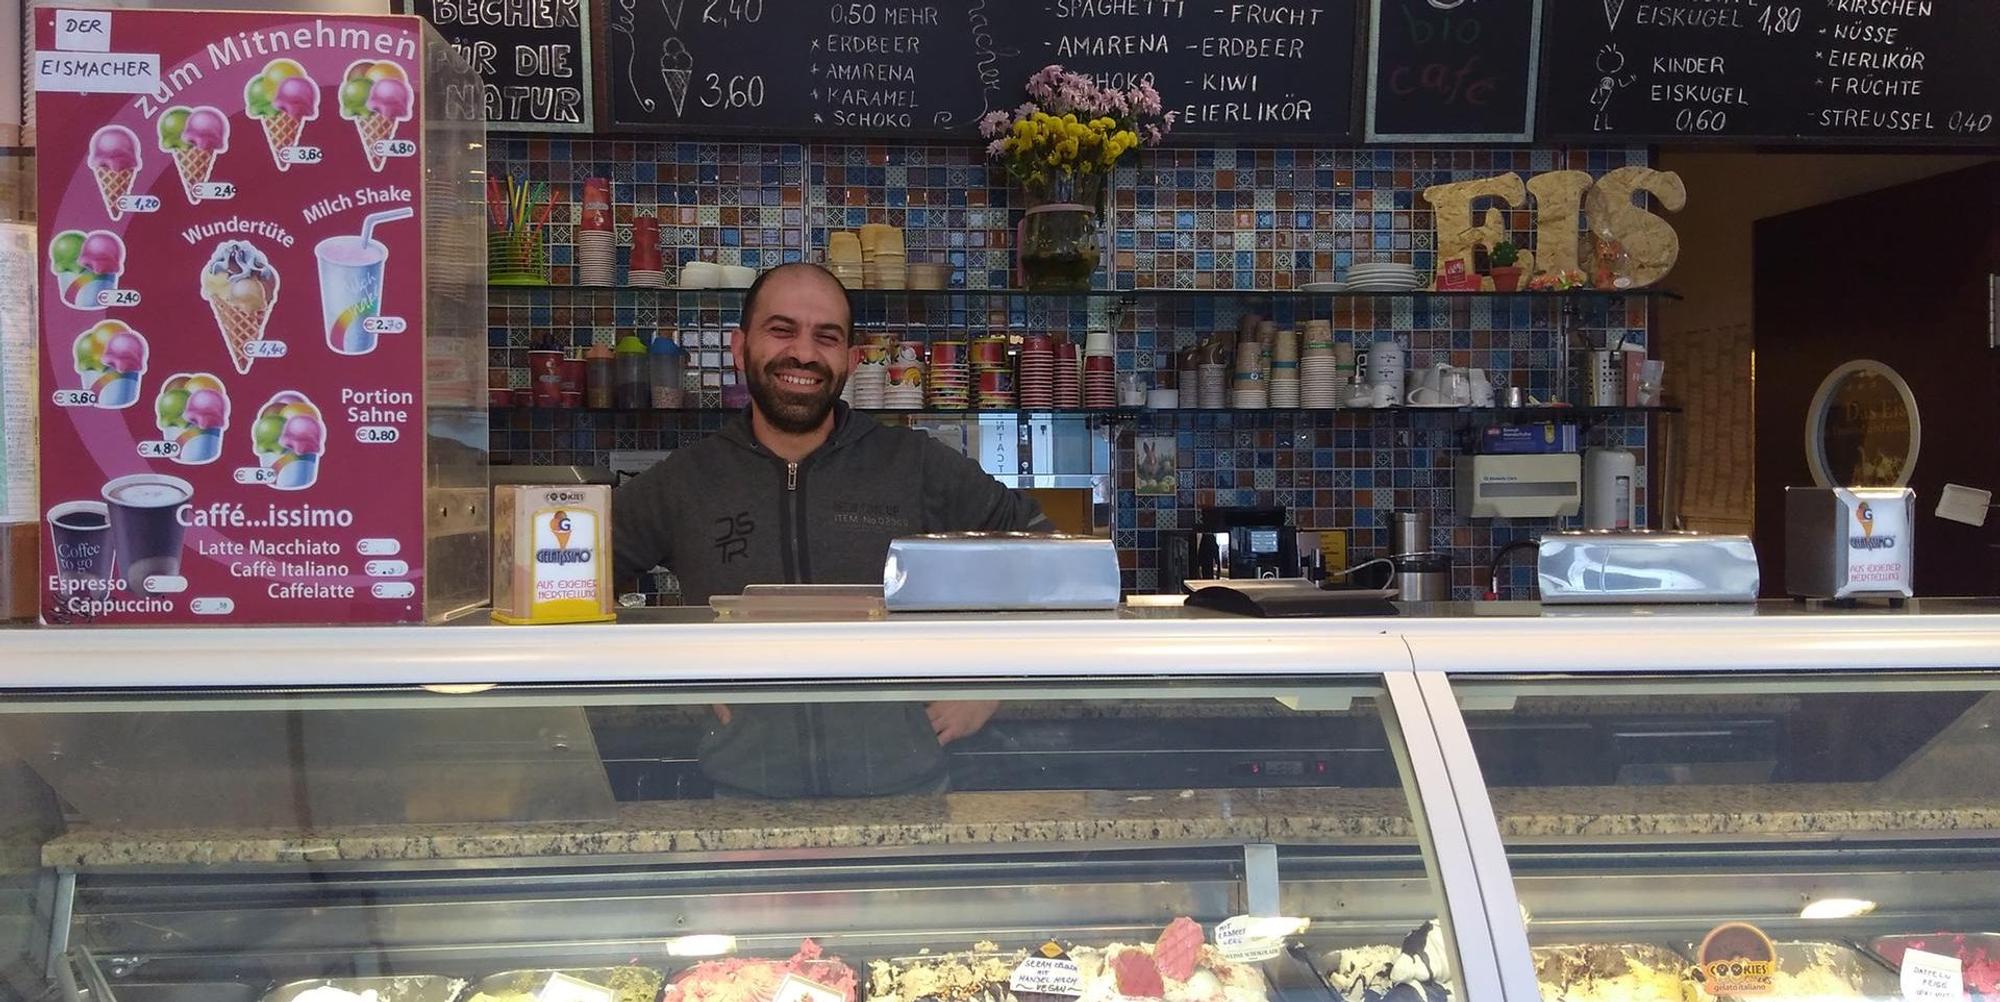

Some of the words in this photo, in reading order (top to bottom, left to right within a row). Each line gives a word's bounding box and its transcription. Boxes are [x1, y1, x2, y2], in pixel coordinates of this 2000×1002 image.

[432, 0, 580, 28] BECHER
[702, 0, 763, 28] 2,40
[831, 4, 876, 25] 0,50
[885, 7, 939, 26] MEHR
[1057, 0, 1184, 18] SPAGHETTI
[1231, 4, 1324, 26] FRUCHT
[1837, 0, 1932, 17] KIRSCHEN
[66, 19, 103, 34] DER
[1637, 5, 1743, 28] EISKUGEL
[1758, 6, 1801, 36] 1,80
[1834, 20, 1898, 45] NÜSSE
[827, 34, 920, 54] ERDBEER
[1057, 34, 1169, 58] AMARENA
[1202, 37, 1304, 59] ERDBEER
[41, 60, 152, 77] EISMACHER
[515, 44, 573, 78] DIE
[1653, 56, 1725, 75] KINDER
[1828, 48, 1925, 70] EIERLIKÖR
[134, 61, 203, 120] zum
[207, 20, 416, 71] Mitnehmen
[826, 63, 916, 84] AMARENA
[700, 73, 764, 110] 3,60
[1203, 73, 1257, 91] KIWI
[1831, 74, 1924, 97] FRÜCHTE
[446, 84, 581, 123] NATUR
[828, 87, 919, 109] KARAMEL
[1651, 84, 1749, 105] EISKUGEL
[1184, 93, 1312, 124] EIERLIKÖR
[833, 110, 912, 129] SCHOKO
[1676, 109, 1726, 132] 0,60
[1819, 109, 1934, 131] STREUSSEL
[1949, 111, 1993, 133] 0,40
[299, 148, 325, 161] 3,60
[302, 194, 352, 225] Milch
[355, 185, 411, 206] Shake
[182, 216, 295, 249] Wundertüte
[1423, 166, 1687, 290] EIS
[341, 389, 413, 404] Portion
[348, 407, 408, 422] Sahne
[559, 518, 571, 531] G
[58, 543, 100, 558] Coffee
[199, 540, 244, 555] Latte
[250, 539, 340, 555] Macchiato
[60, 559, 72, 570] to
[77, 559, 92, 573] go
[282, 561, 349, 577] Italiano
[49, 575, 127, 595] Espresso
[268, 583, 354, 599] Caffelatte
[68, 597, 173, 616] Cappuccino
[1036, 984, 1066, 993] VEGAN
